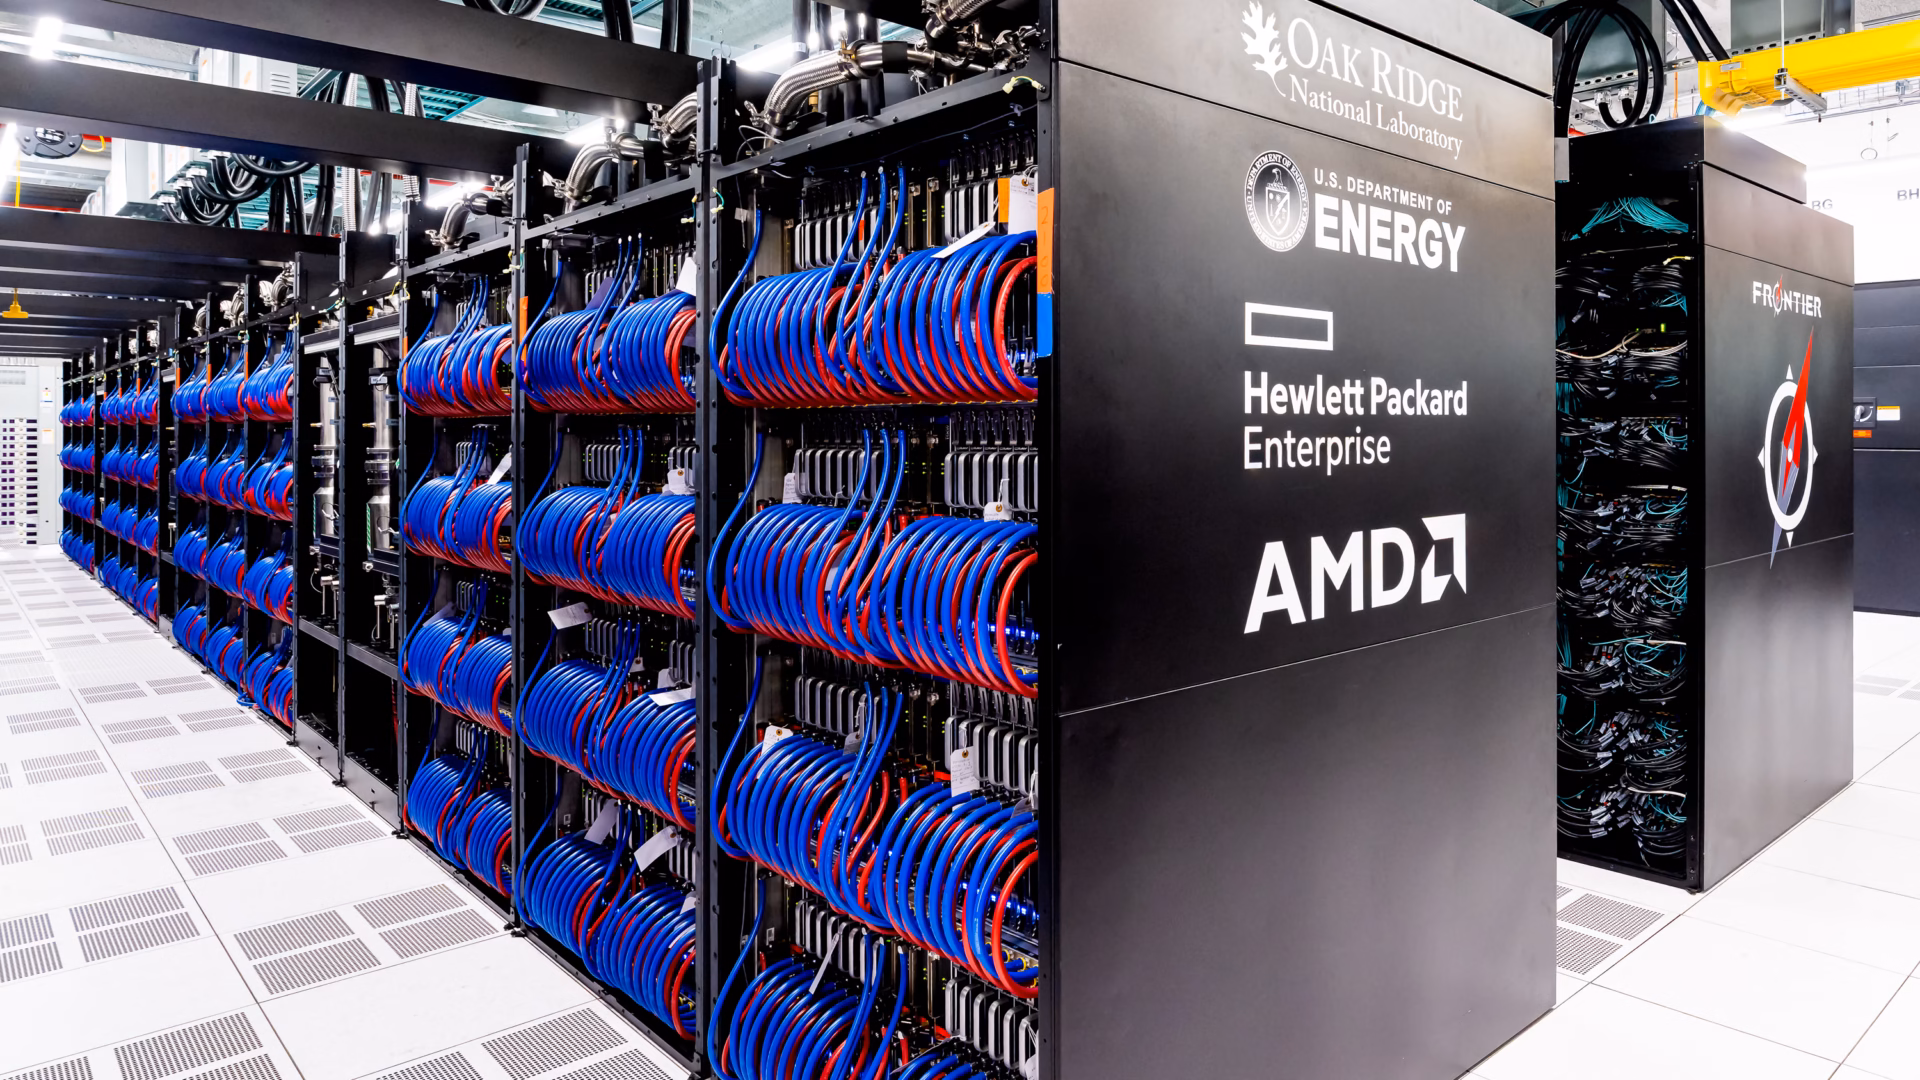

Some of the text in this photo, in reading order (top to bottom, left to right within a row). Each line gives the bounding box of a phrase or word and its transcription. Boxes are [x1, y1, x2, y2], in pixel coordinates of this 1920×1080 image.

[1287, 17, 1464, 121] OAK RIDGE
[1289, 74, 1463, 160] National Laboratory
[1314, 168, 1452, 215] U.S. DEPARTMENT OF
[1314, 193, 1466, 272] ENERGY
[1752, 281, 1822, 318] FRONTIER
[1244, 371, 1468, 416] Hewlett Packard
[1244, 426, 1391, 476] Enterprise
[1244, 527, 1415, 634] AMD
